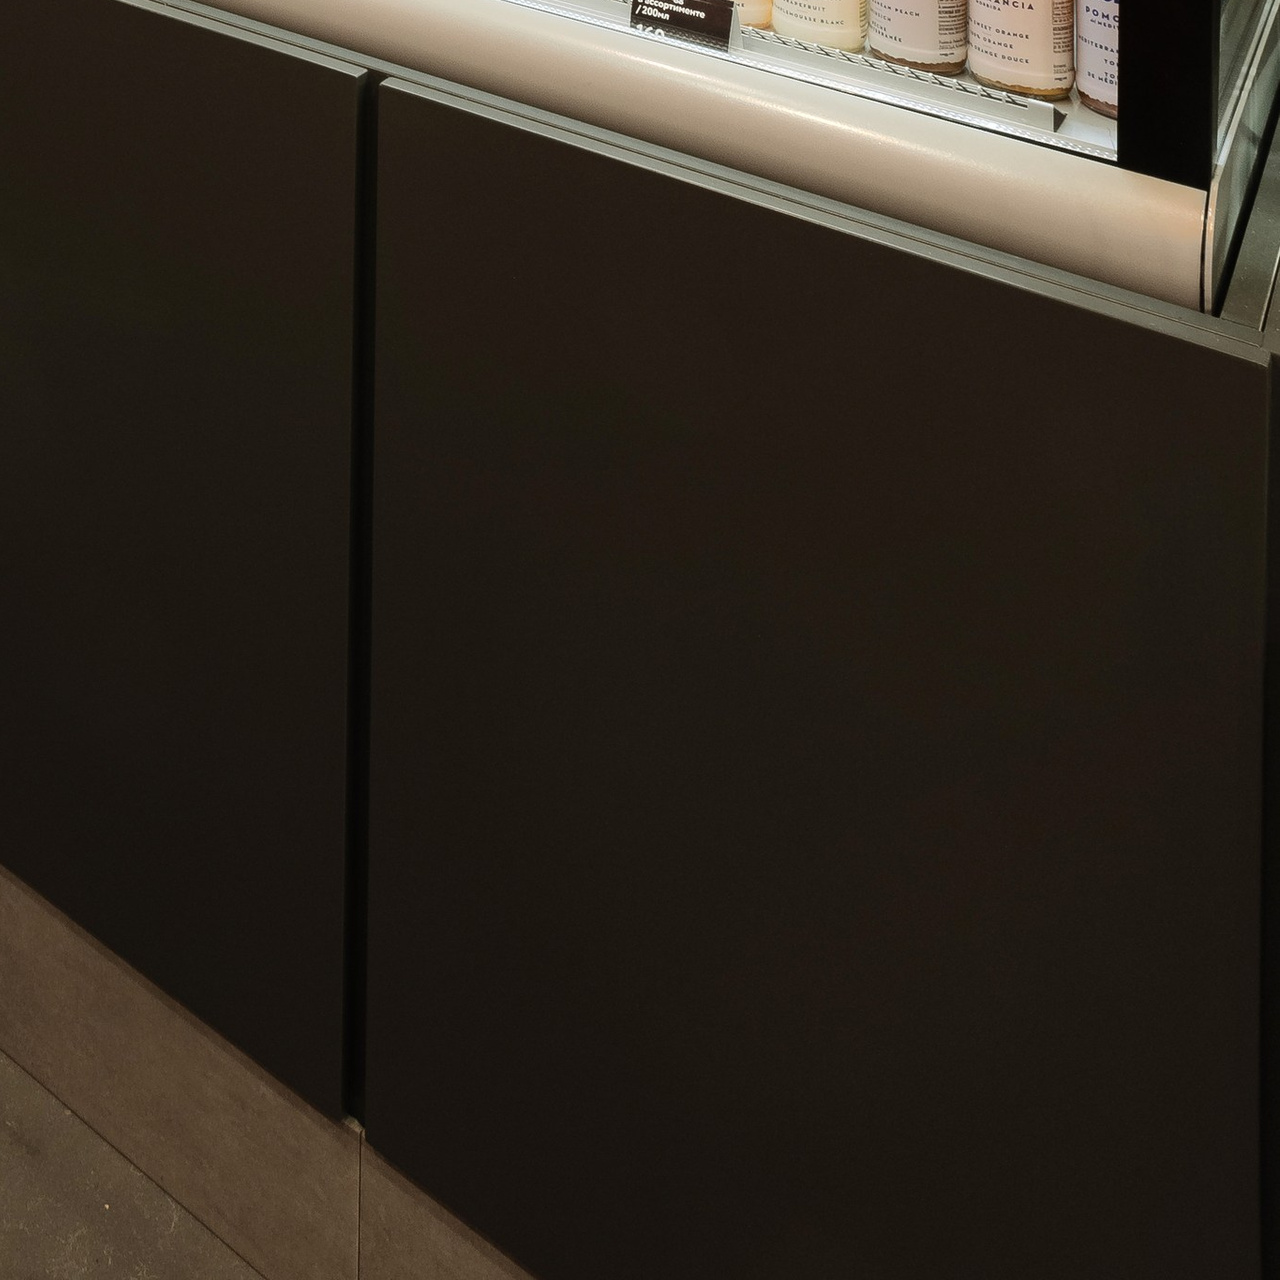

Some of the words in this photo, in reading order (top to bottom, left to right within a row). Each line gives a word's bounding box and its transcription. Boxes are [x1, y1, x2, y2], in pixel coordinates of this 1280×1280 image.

[635, 5, 670, 21] /200мл
[895, 8, 920, 17] PEACH
[995, 28, 1030, 40] ORANGE
[982, 37, 1014, 49] ORANGE
[1001, 54, 1030, 64] DOUCE
